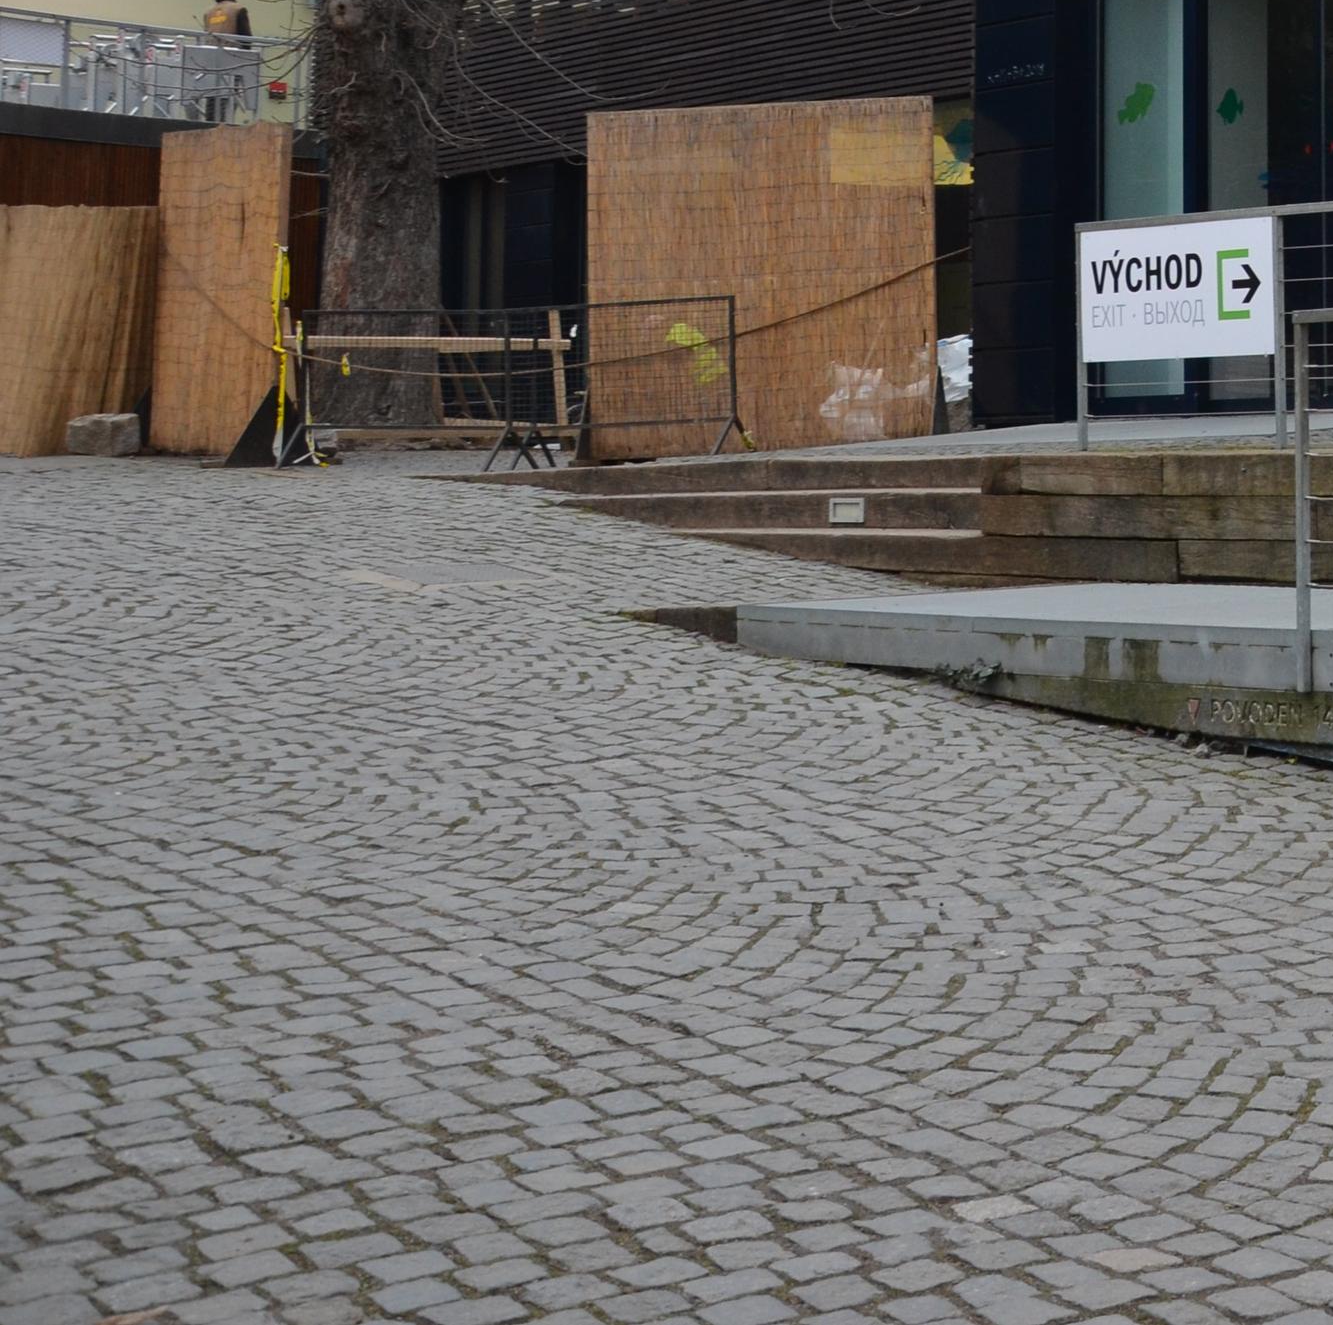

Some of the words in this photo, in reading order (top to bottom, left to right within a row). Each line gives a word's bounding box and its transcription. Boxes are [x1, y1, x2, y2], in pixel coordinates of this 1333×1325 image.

[1091, 249, 1203, 295] VÝCHOD
[1091, 304, 1126, 328] EXIT
[1143, 299, 1206, 328] ВЫХОД
